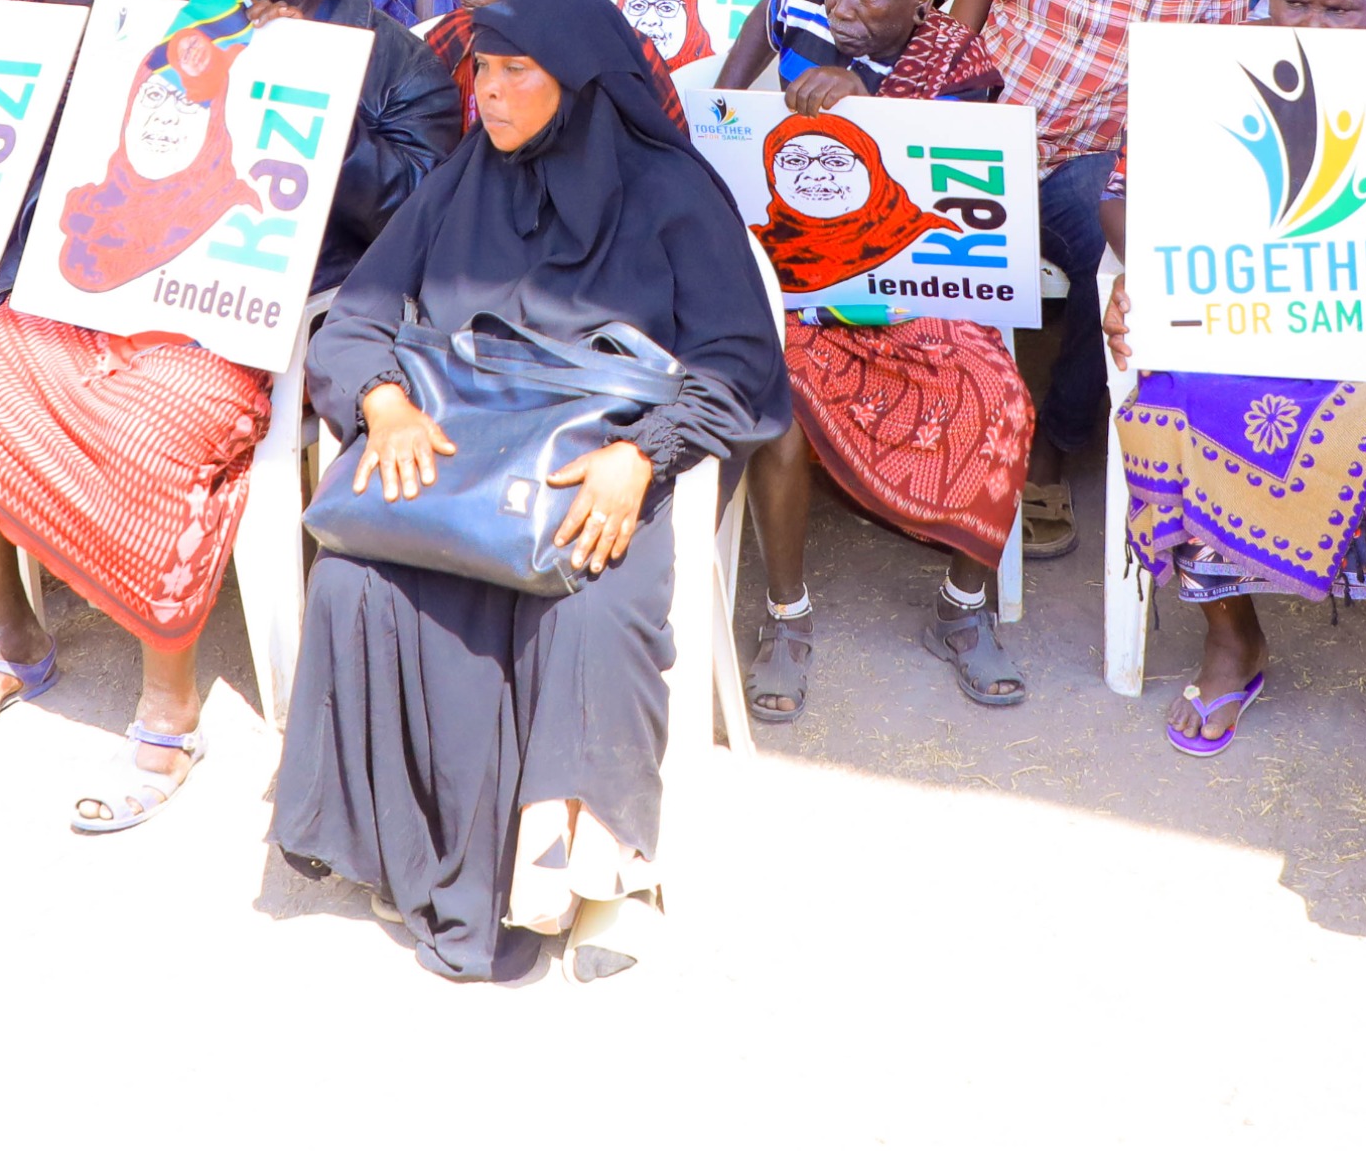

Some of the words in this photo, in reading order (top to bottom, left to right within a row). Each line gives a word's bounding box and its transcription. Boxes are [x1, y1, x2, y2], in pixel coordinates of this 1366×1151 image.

[695, 124, 752, 136] TOGETHER
[722, 134, 746, 142] SAMIA
[153, 270, 282, 328] iendelee
[867, 274, 1014, 301] iendelee
[1205, 302, 1272, 335] FOR
